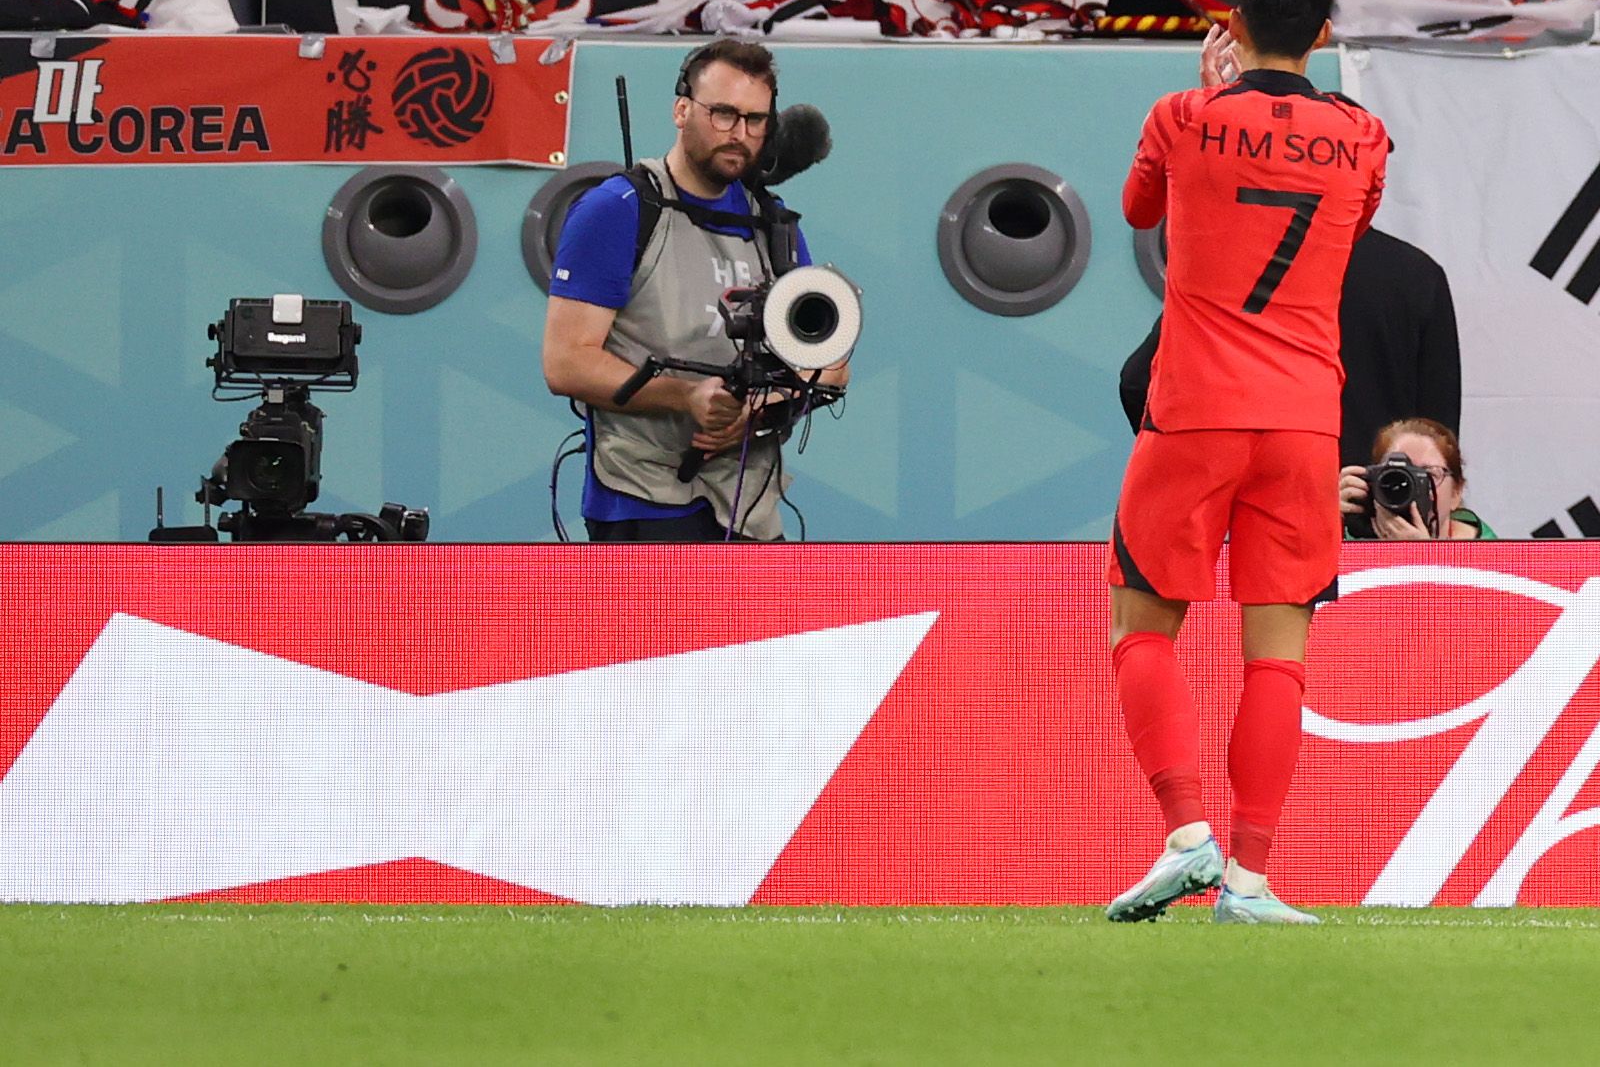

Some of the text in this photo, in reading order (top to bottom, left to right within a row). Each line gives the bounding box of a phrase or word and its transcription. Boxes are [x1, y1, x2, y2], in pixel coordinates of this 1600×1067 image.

[33, 59, 105, 125] 마
[0, 105, 271, 155] A COREA
[1282, 134, 1360, 171] SON
[1235, 186, 1325, 315] 7
